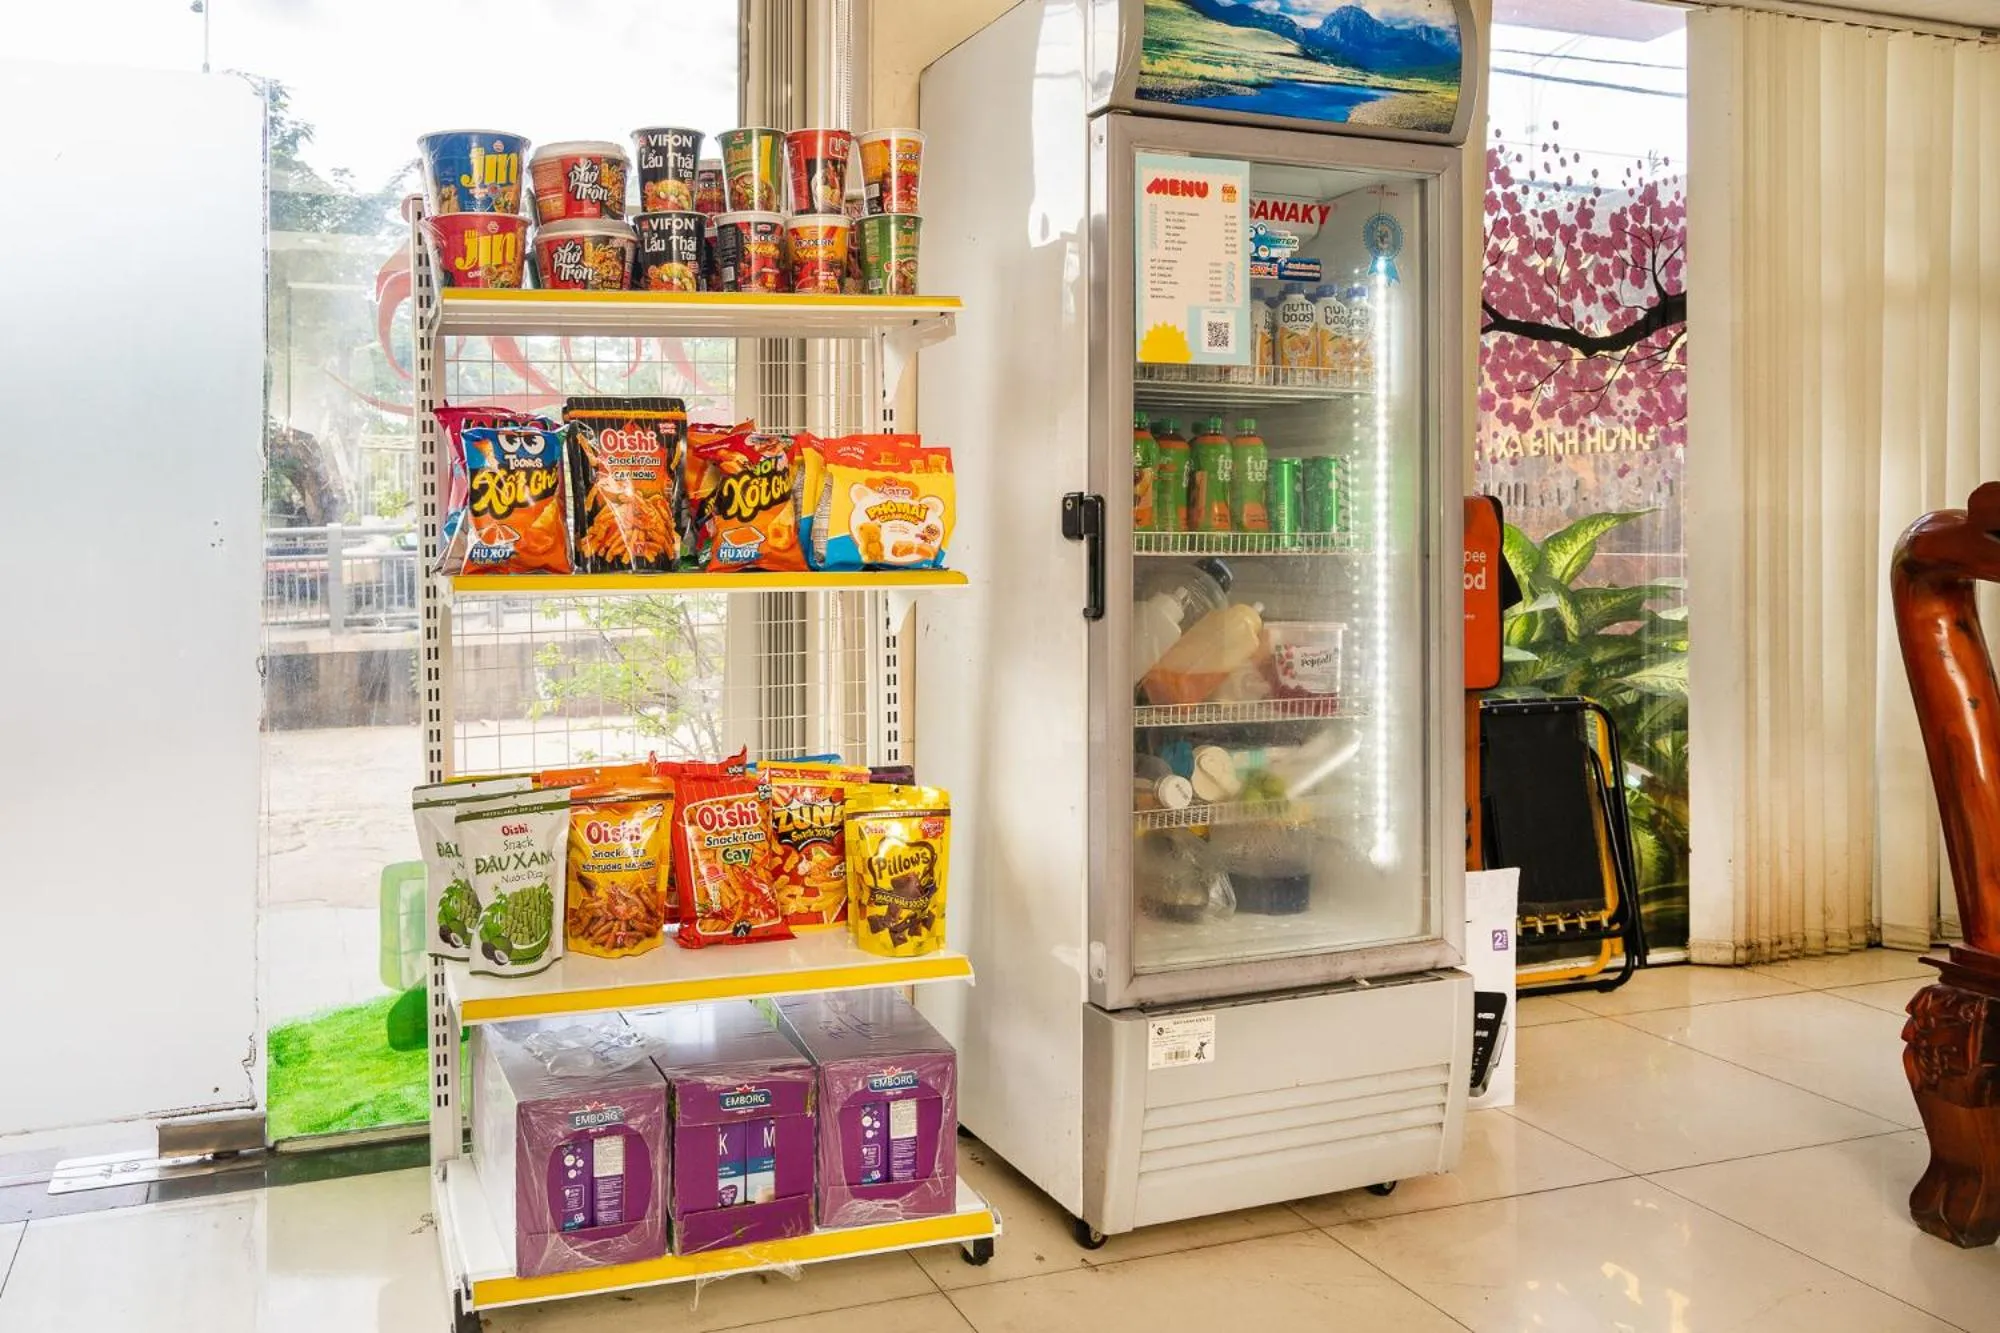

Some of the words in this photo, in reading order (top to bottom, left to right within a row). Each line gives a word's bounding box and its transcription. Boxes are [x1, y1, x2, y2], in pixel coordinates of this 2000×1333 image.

[647, 134, 693, 148] VIFON
[1146, 177, 1208, 198] MENU
[649, 217, 695, 231] VIFON
[1282, 312, 1314, 323] boost
[600, 428, 659, 453] Oishi
[696, 801, 761, 833] Oishi
[502, 823, 529, 837] Oishi
[503, 836, 534, 852] Snack
[706, 833, 738, 847] Snack
[721, 847, 752, 866] Cay
[874, 851, 930, 880] Pillows
[874, 1074, 913, 1089] EMBORG
[725, 1094, 767, 1107] EMBORG
[575, 1111, 618, 1126] EMBORG
